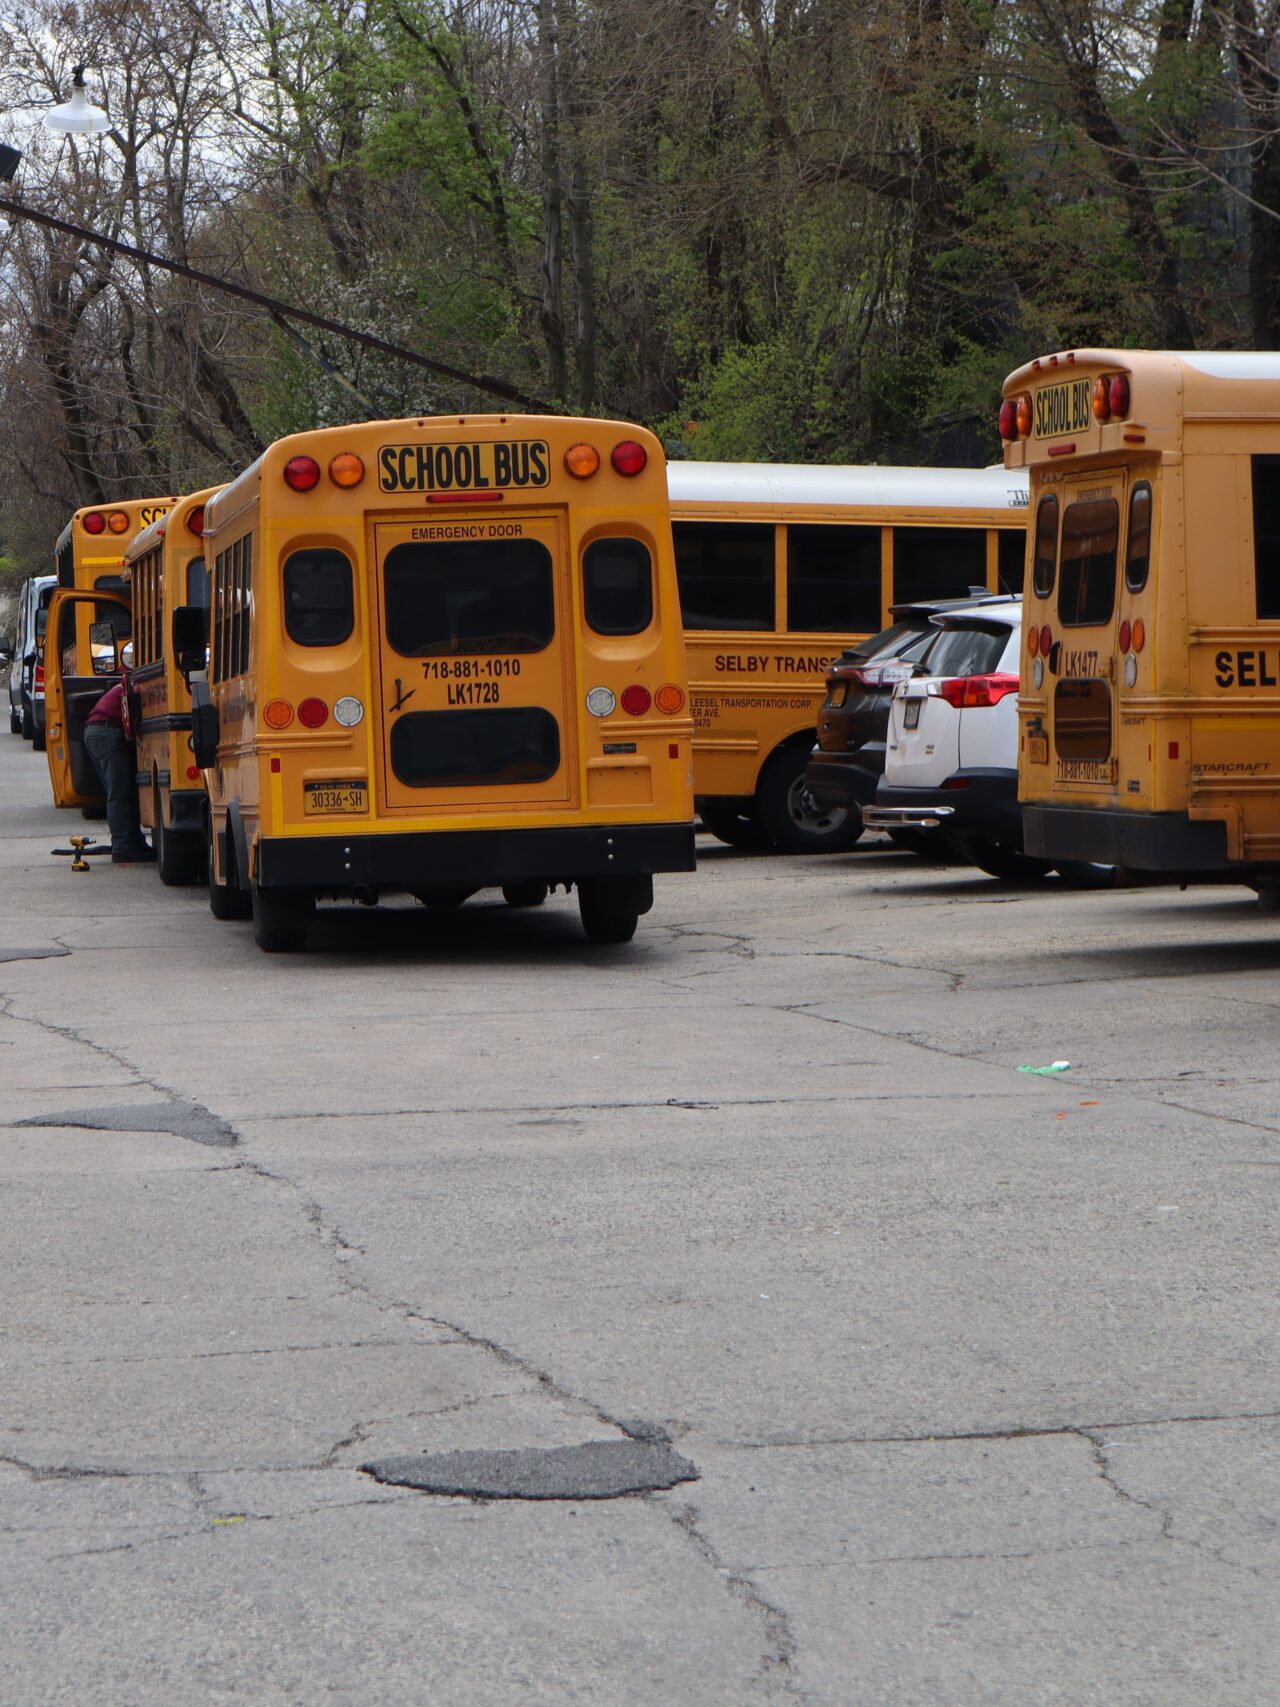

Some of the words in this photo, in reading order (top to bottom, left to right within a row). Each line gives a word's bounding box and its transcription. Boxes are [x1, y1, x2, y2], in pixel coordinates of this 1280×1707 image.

[1036, 385, 1071, 437] SCHOOL
[1072, 380, 1089, 430] BUS
[380, 444, 490, 491] SCHOOL
[493, 442, 547, 487] BUS
[411, 525, 486, 540] EMERGENCY
[488, 524, 523, 538] DOOR
[421, 658, 521, 680] 718-881-1010
[714, 655, 770, 673] SELBY
[773, 656, 837, 673] TRANS
[1065, 650, 1099, 678] LK1477
[446, 681, 500, 706] LK1728
[720, 698, 789, 710] TRANSPORTATION
[790, 699, 813, 710] CORP.
[703, 708, 721, 718] AVE.
[1056, 760, 1099, 781] 718-881-1010
[1192, 762, 1271, 773] STARCRAFT
